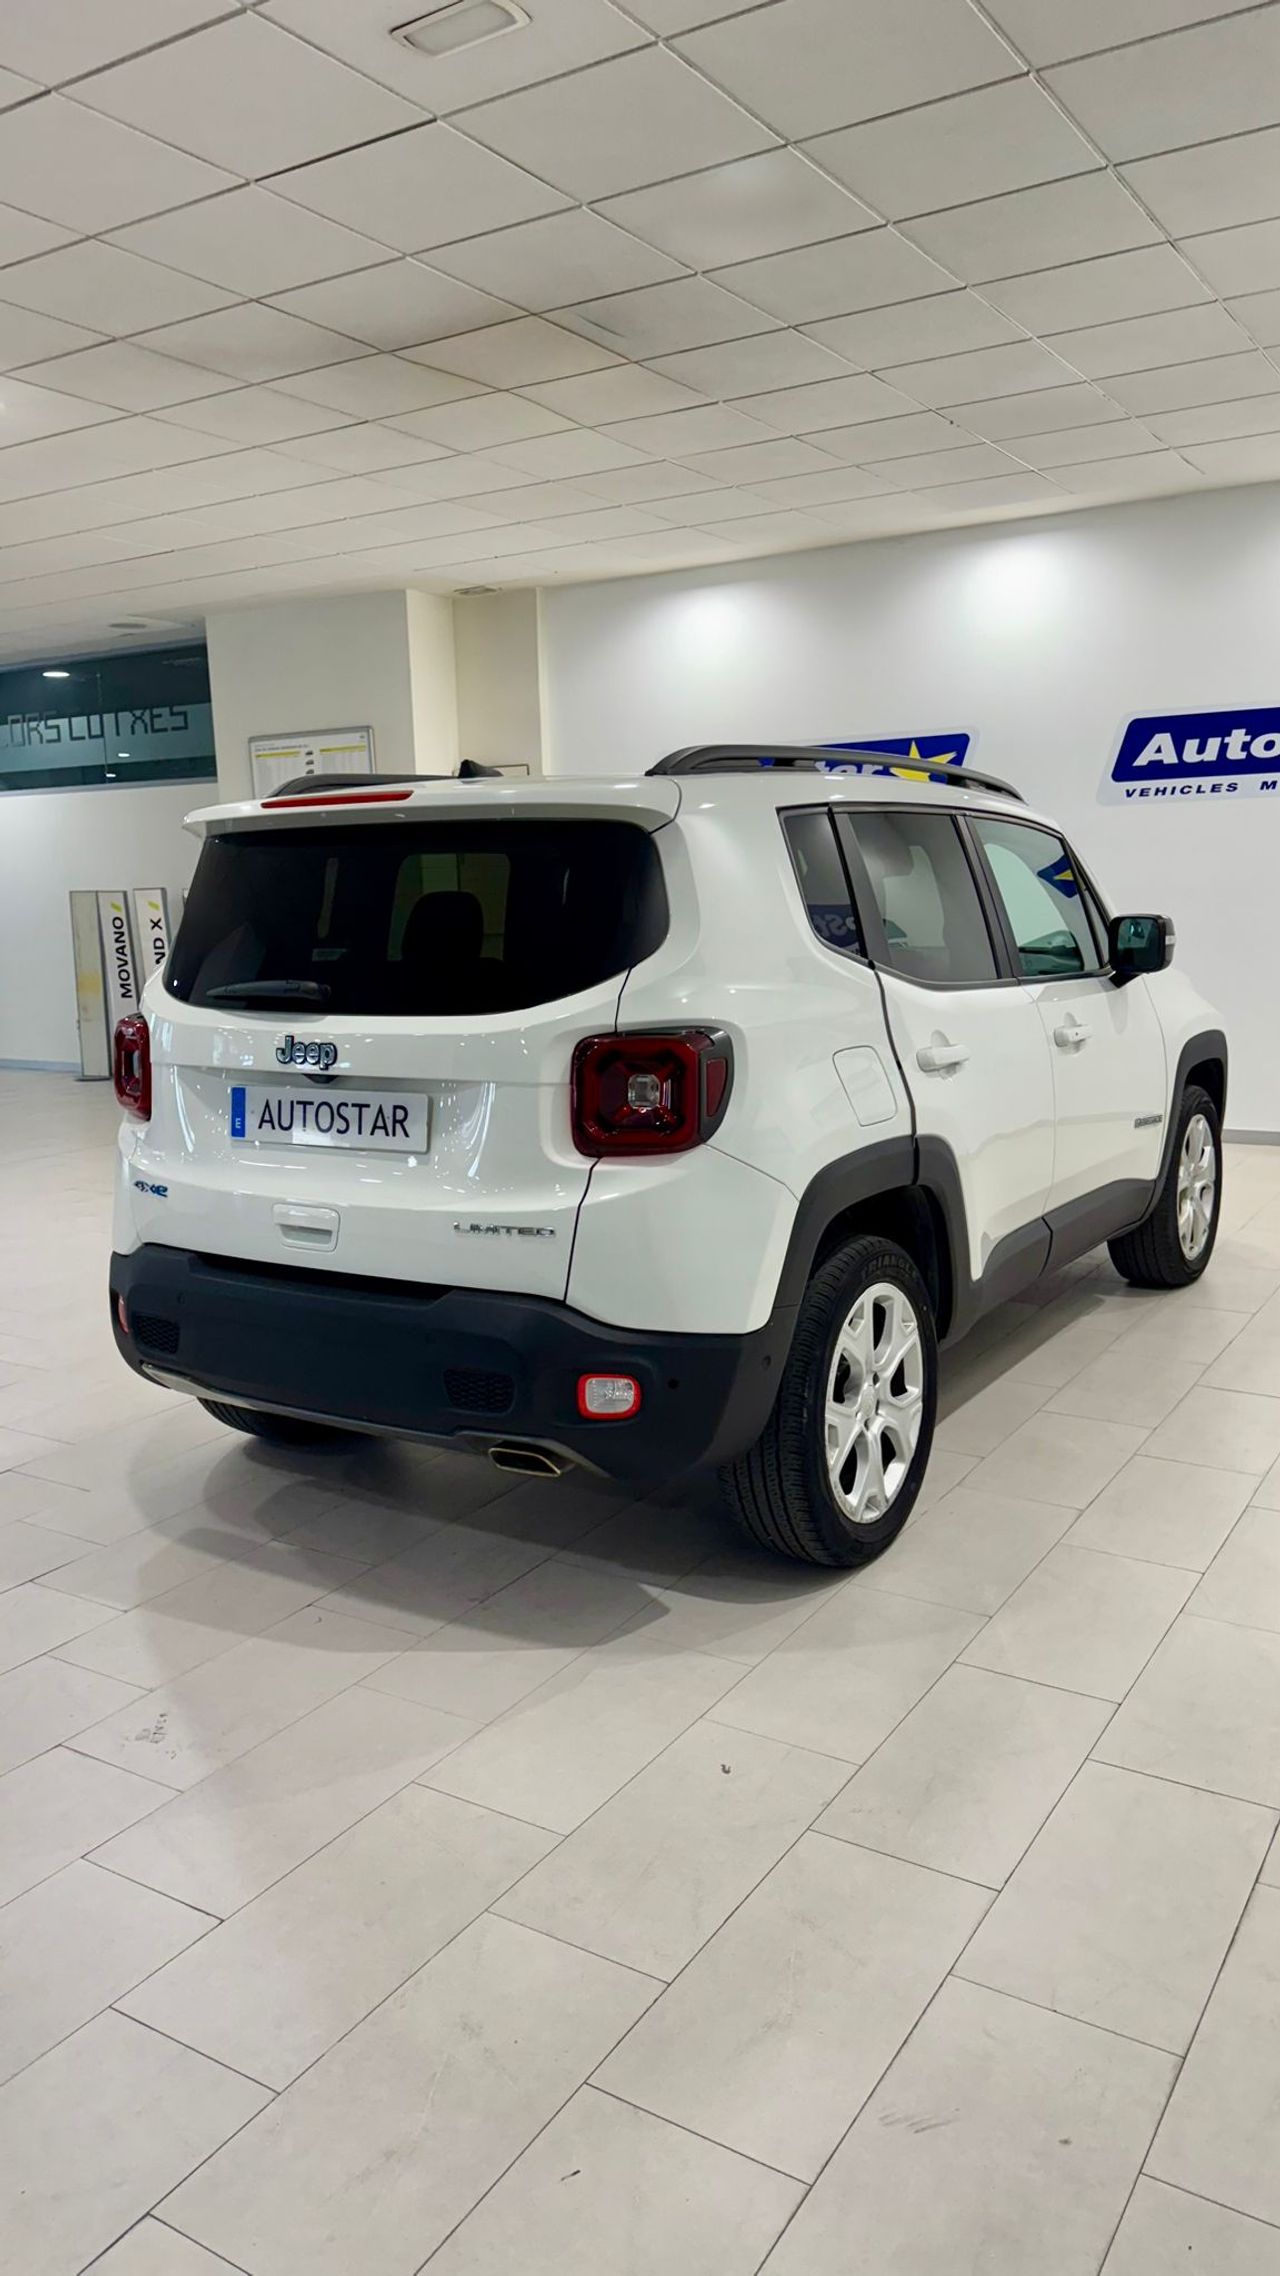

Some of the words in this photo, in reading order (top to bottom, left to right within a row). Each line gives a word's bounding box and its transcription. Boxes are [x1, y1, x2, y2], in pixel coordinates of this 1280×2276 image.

[1132, 728, 1280, 767] Auto
[1125, 782, 1239, 798] VEHICLES
[150, 918, 163, 931] X
[112, 916, 133, 999] MOVANO
[275, 1035, 338, 1071] Jeep
[257, 1098, 411, 1139] AUTOSTAR
